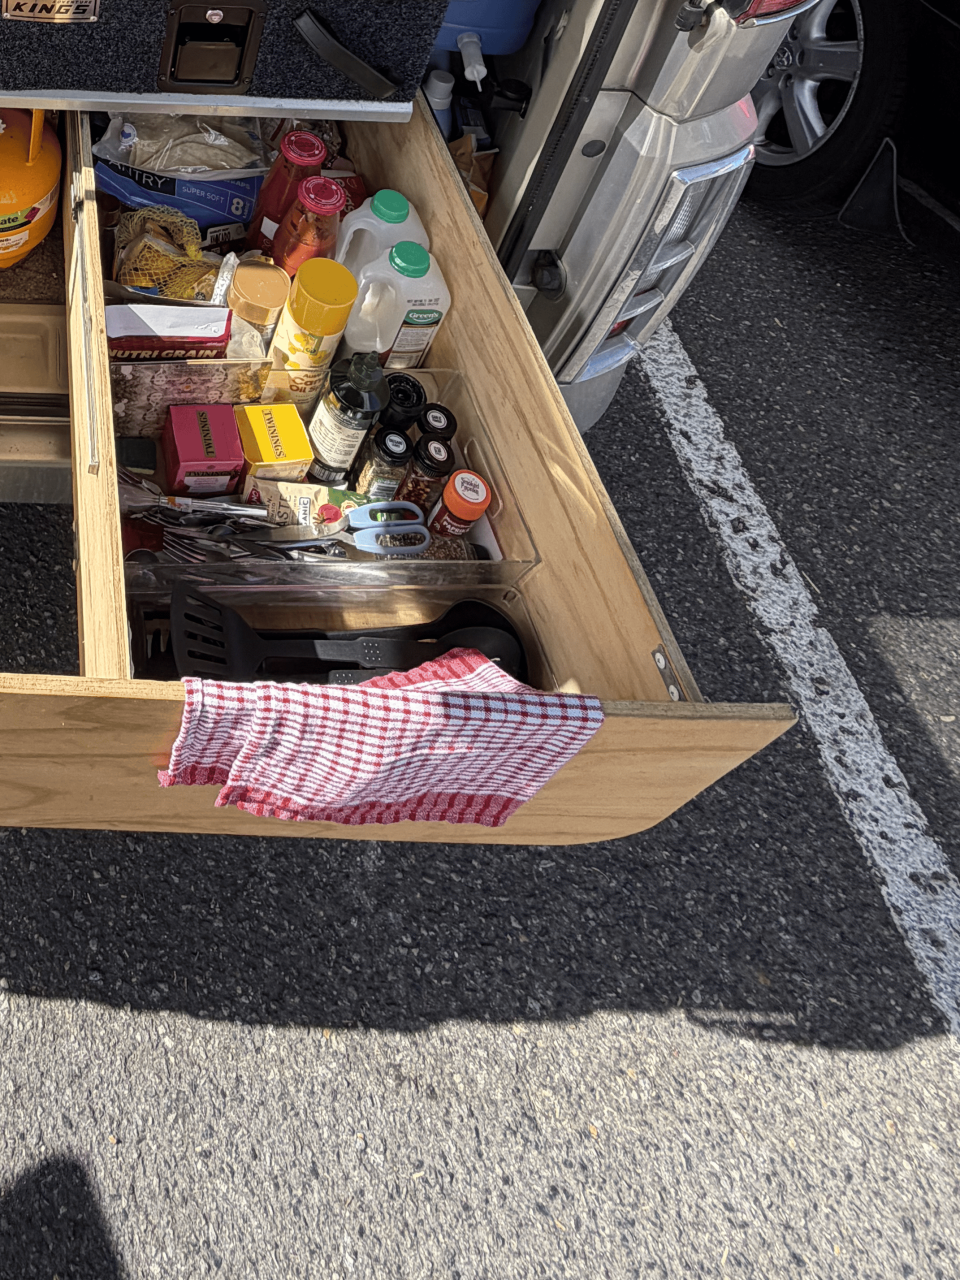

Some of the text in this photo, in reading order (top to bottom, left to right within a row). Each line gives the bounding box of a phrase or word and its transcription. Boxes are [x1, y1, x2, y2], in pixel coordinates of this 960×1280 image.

[12, 2, 90, 14] KINGS
[182, 186, 225, 203] SUPER SOFT
[231, 197, 244, 215] 8
[160, 349, 218, 358] GRAIN
[289, 384, 307, 393] Oil
[199, 411, 215, 457] TWININGS
[264, 410, 285, 458] TWININGS
[277, 495, 291, 526] ASTE
[301, 500, 309, 526] ANIC
